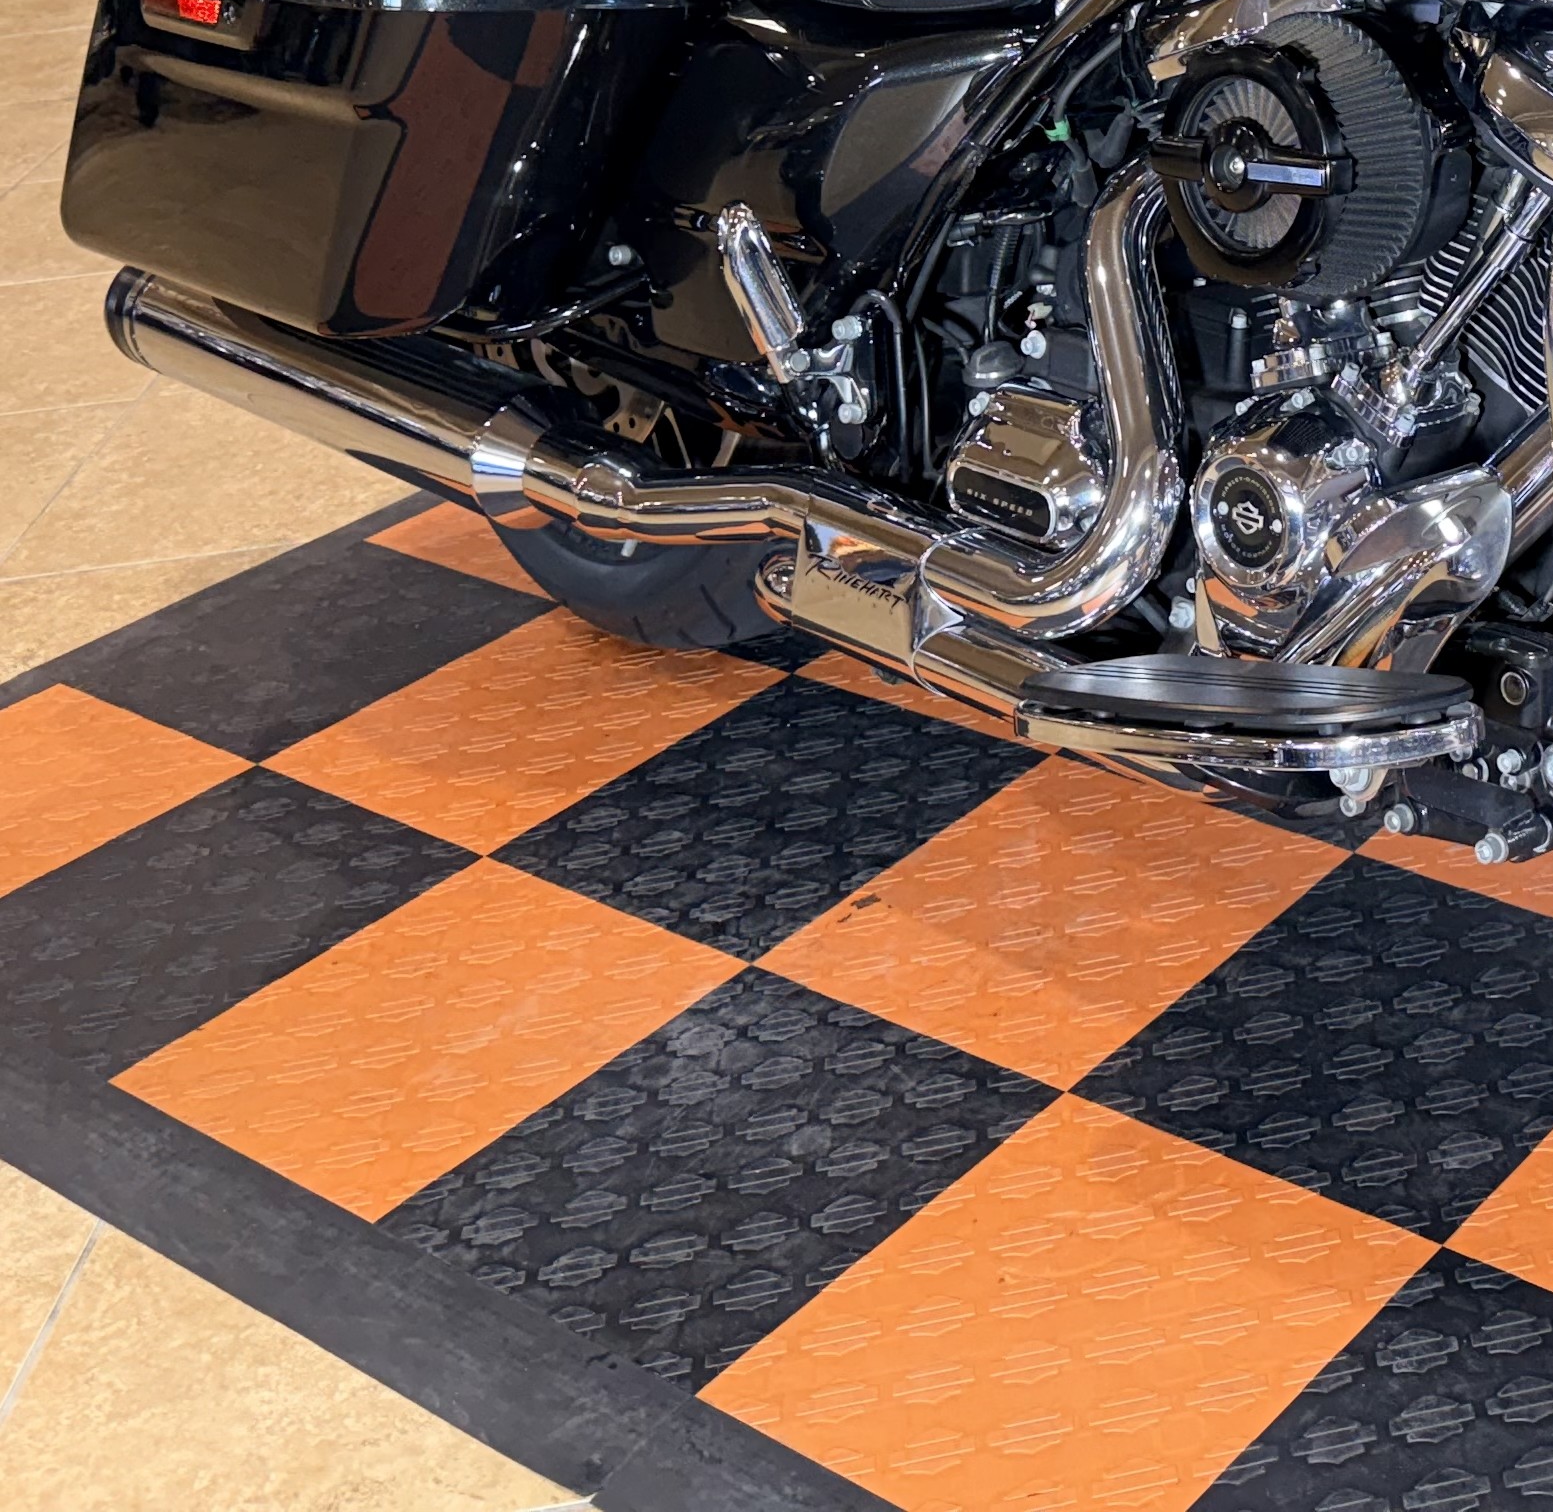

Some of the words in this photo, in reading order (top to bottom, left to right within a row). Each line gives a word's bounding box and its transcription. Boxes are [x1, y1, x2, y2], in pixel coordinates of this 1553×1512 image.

[966, 488, 987, 501] SIX
[993, 498, 1034, 517] SPEED
[806, 553, 905, 609] RINEHART
